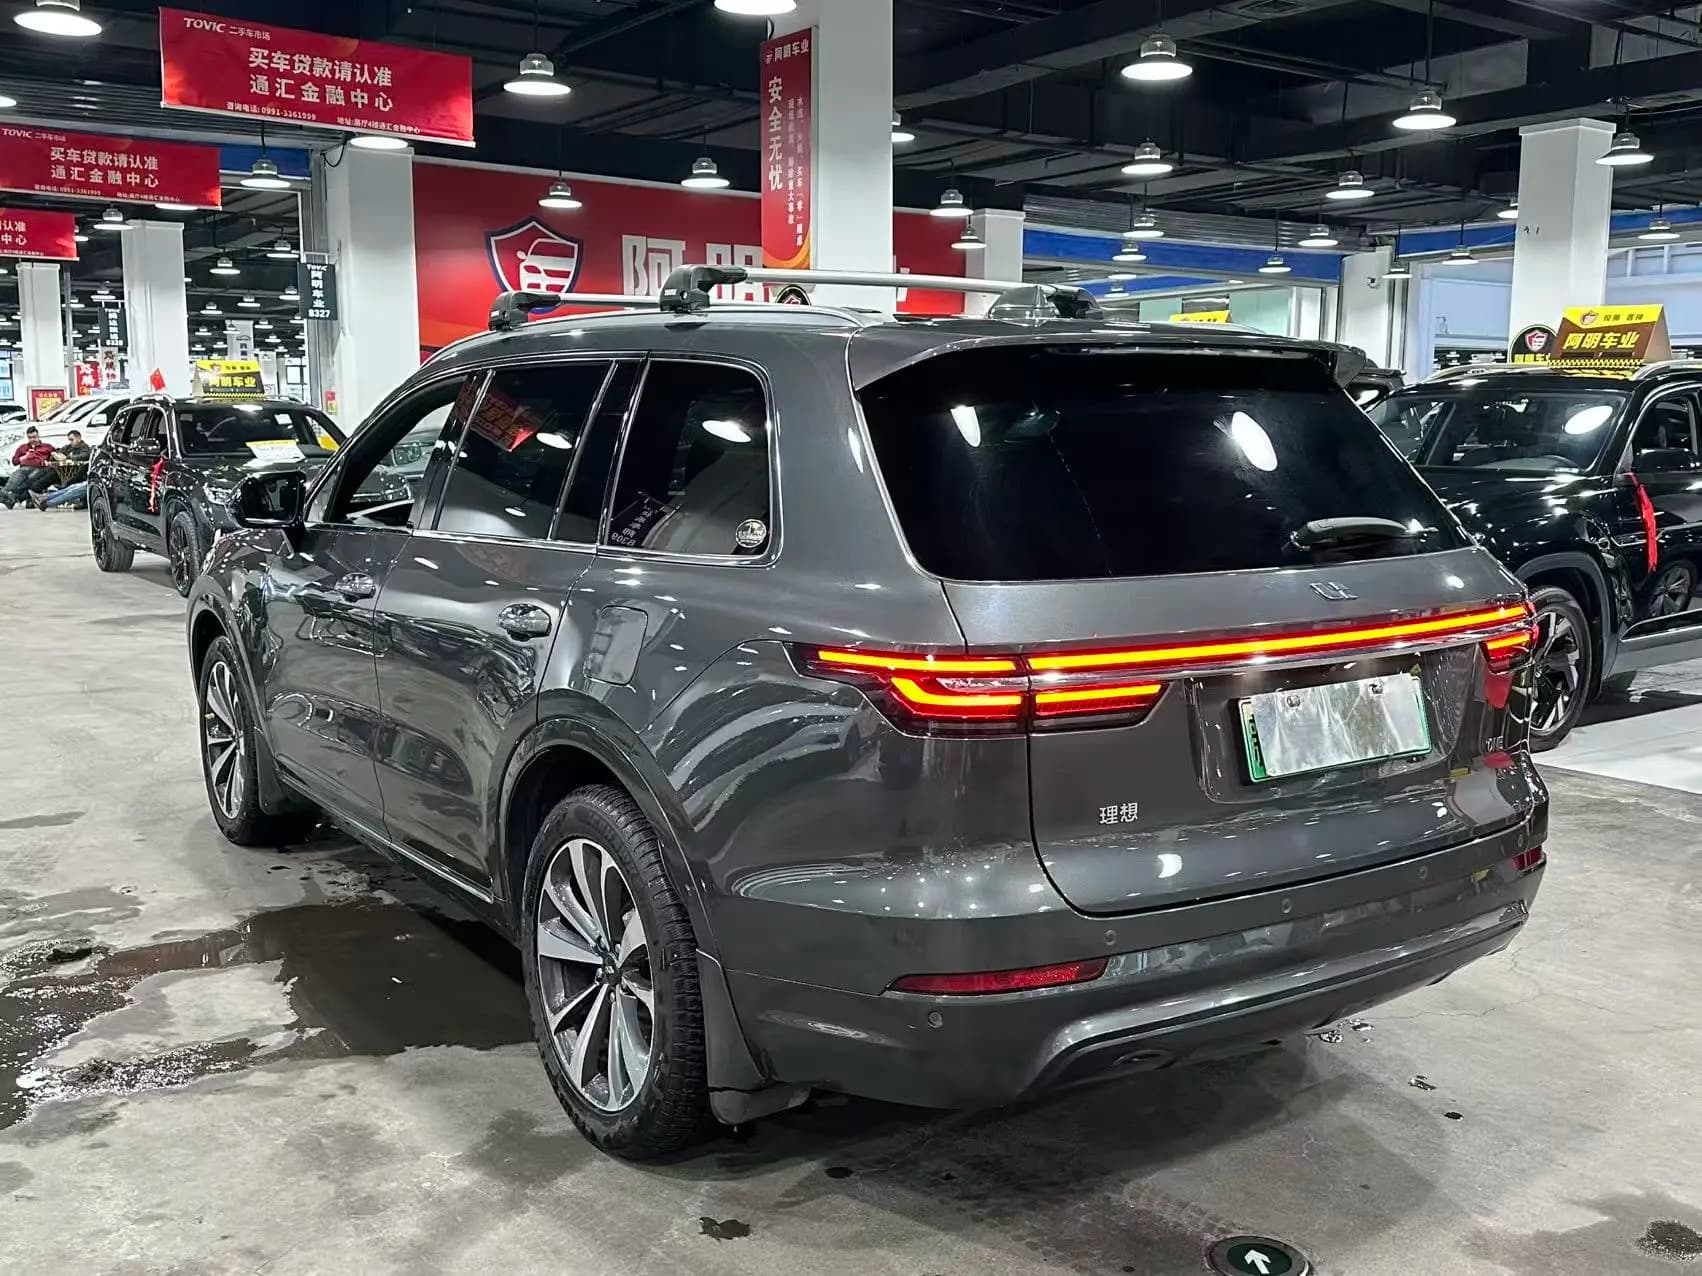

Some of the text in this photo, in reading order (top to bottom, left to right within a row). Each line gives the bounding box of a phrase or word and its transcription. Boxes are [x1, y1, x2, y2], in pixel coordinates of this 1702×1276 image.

[184, 17, 271, 41] TOVIC 二手车市场
[249, 47, 392, 87] 买车贷款请认准
[250, 75, 393, 112] 通汇金融中心
[2, 128, 33, 139] TOVIC
[768, 76, 783, 192] 安全无忧
[51, 146, 159, 170] 买车贷款请认准
[51, 165, 159, 188] 通汇金融中心
[0, 219, 26, 232] 认准
[1562, 331, 1640, 349] 阿明车业
[1099, 802, 1138, 824] 理想
